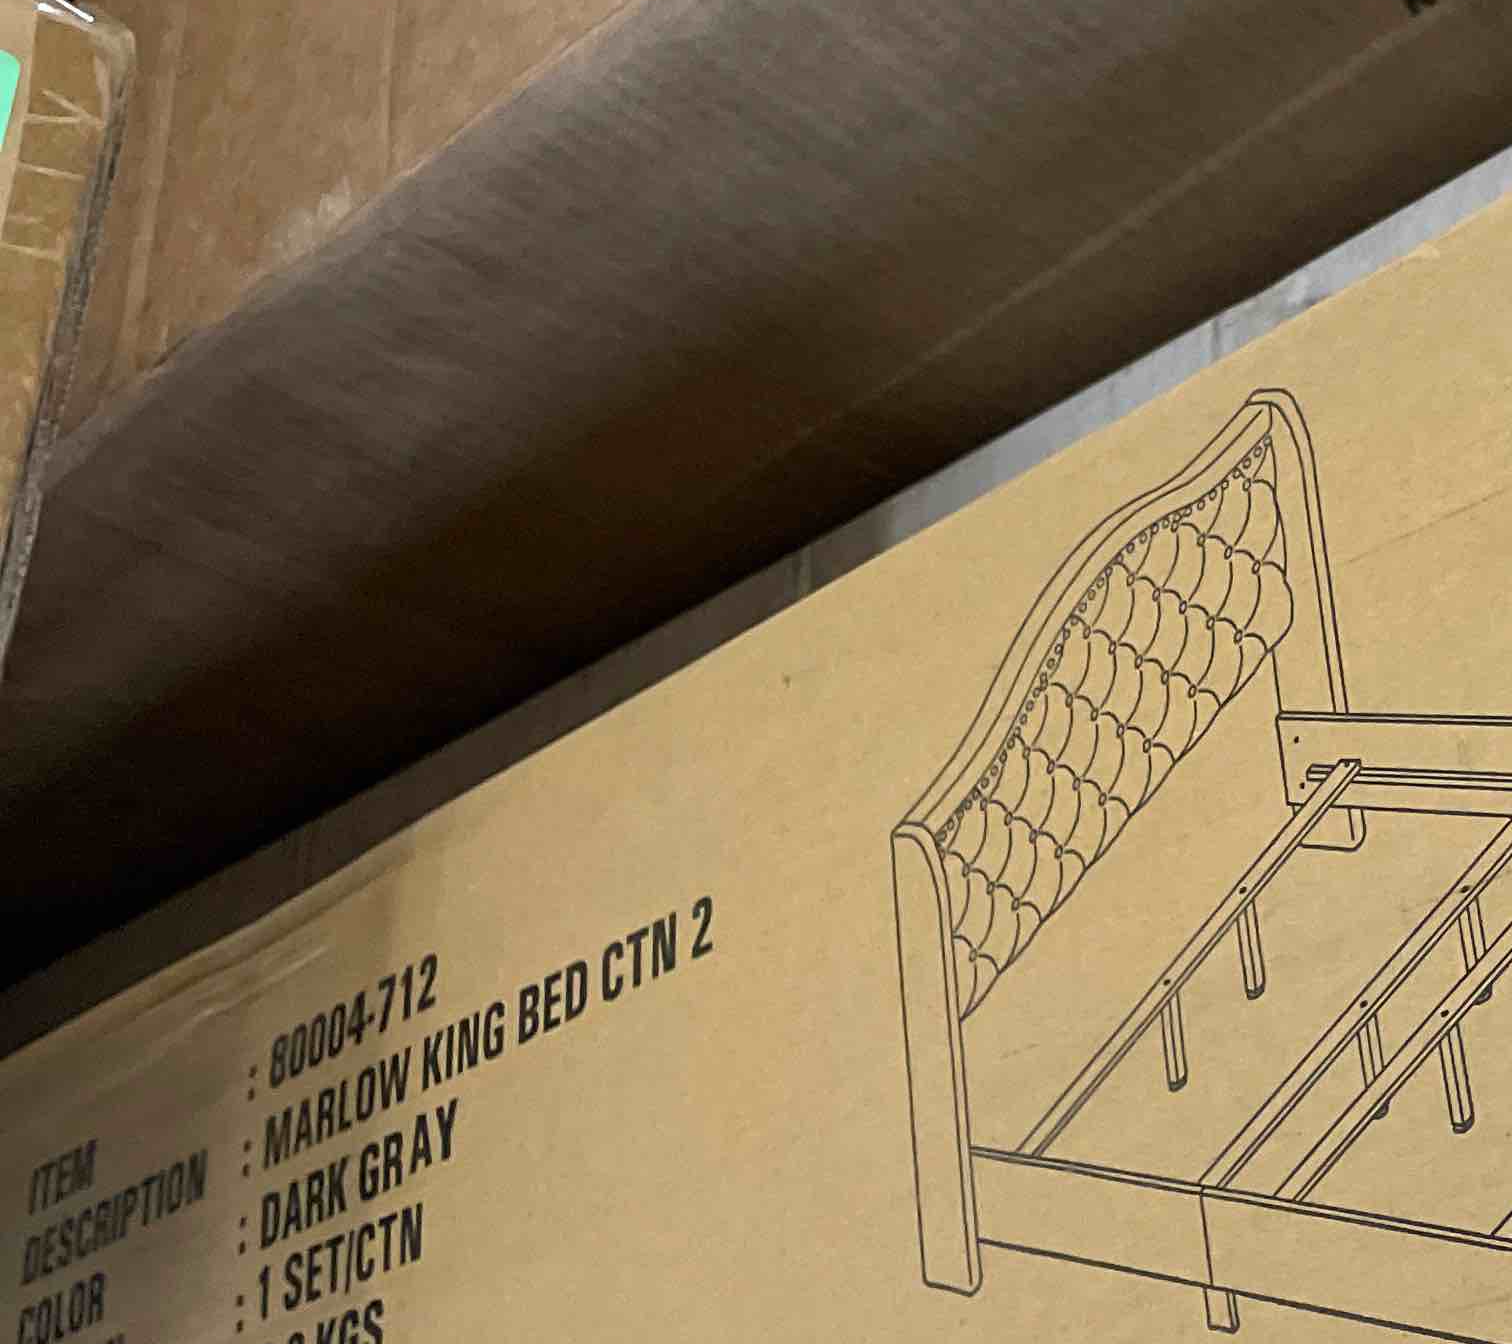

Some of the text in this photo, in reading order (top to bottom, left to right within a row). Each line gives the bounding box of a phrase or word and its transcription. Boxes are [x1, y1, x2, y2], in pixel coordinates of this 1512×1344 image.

[20, 1149, 208, 1286] DESCRIPTION
[262, 1046, 412, 1171] MARLOW
[421, 1001, 506, 1092] KING
[517, 959, 589, 1045] BED
[601, 911, 678, 1003] CTN
[690, 895, 714, 960] 2
[28, 1138, 98, 1216] ITEM
[259, 1154, 349, 1251] DARK
[359, 1096, 459, 1203] GRAY
[258, 1264, 271, 1319] 1
[283, 1202, 424, 1313] SET/CTN
